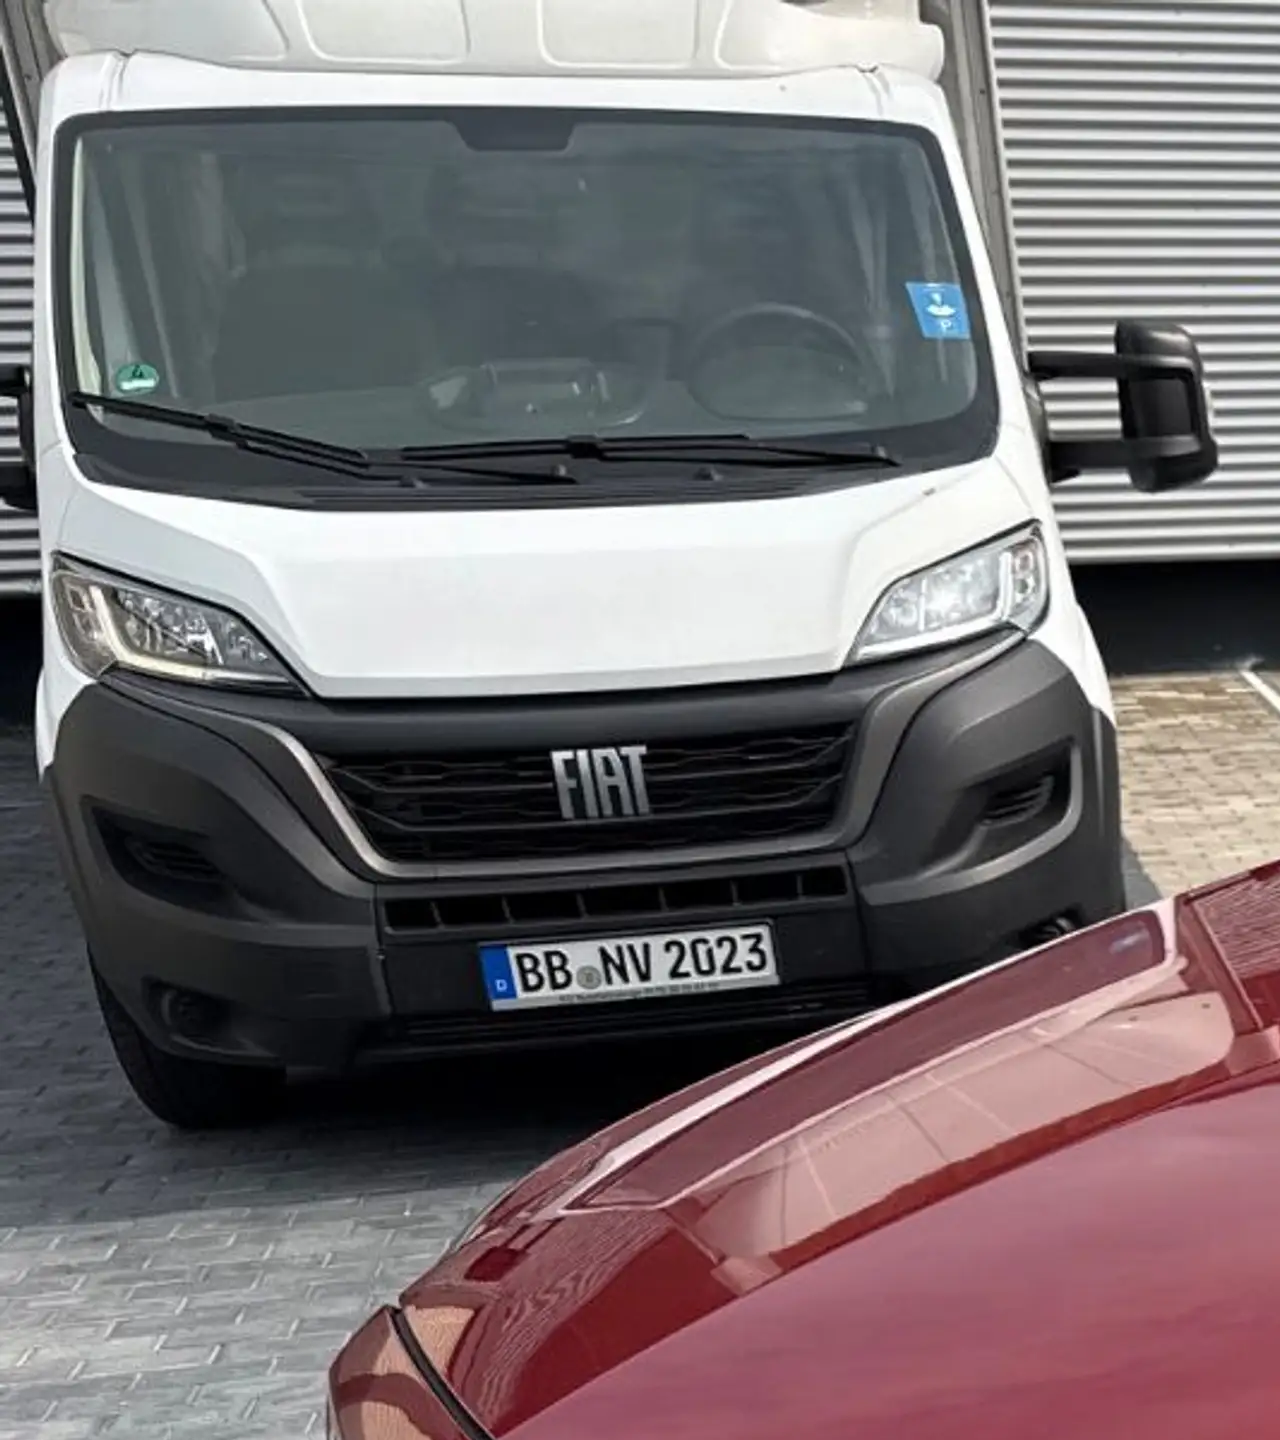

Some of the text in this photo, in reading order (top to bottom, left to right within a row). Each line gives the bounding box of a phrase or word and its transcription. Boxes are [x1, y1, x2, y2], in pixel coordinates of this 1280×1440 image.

[551, 746, 650, 819] FIAT
[496, 979, 507, 991] D
[515, 950, 573, 993] BB
[599, 942, 652, 985] NV
[664, 933, 767, 979] 2023
